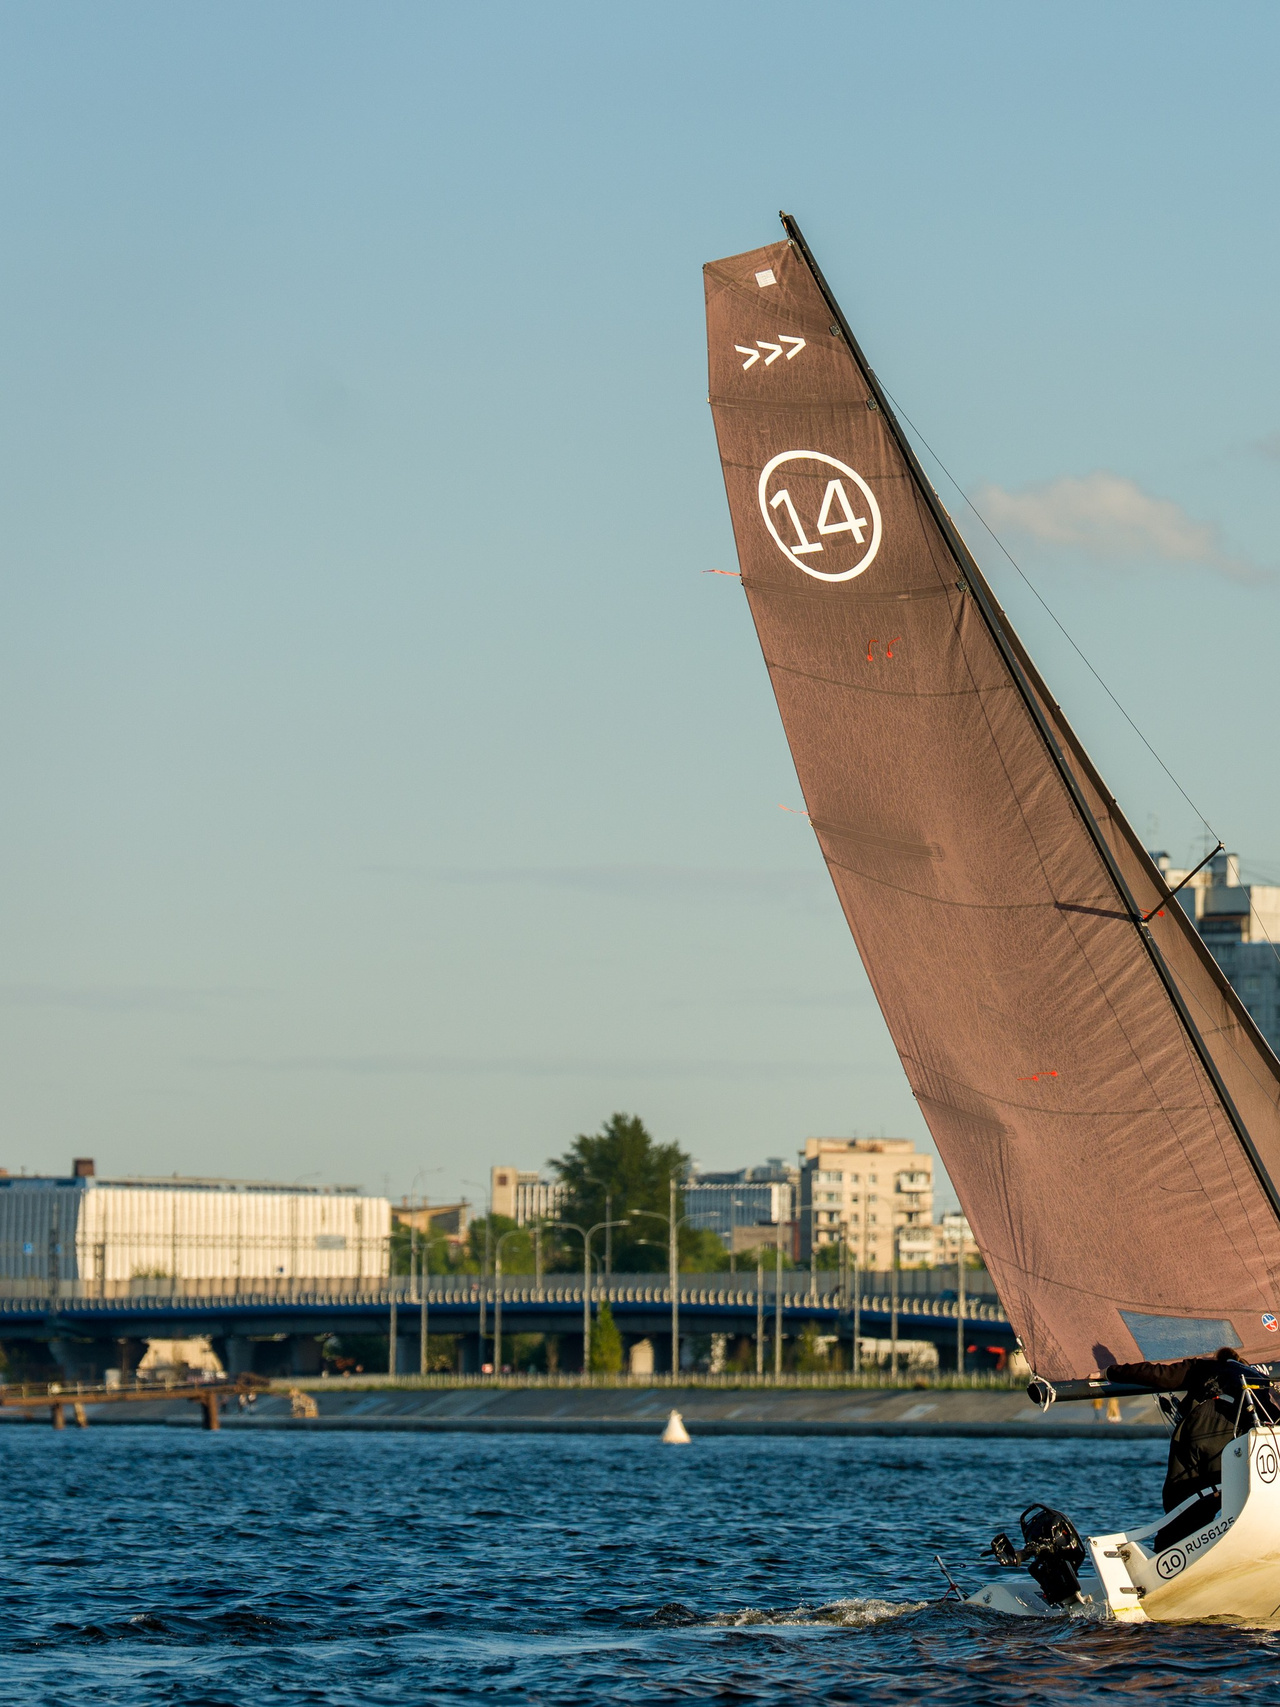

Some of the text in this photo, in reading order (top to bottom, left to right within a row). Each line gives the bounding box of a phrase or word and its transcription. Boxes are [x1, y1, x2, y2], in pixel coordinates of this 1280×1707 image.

[768, 478, 868, 555] 14
[1258, 1453, 1276, 1475] 10
[1161, 1554, 1182, 1575] 10
